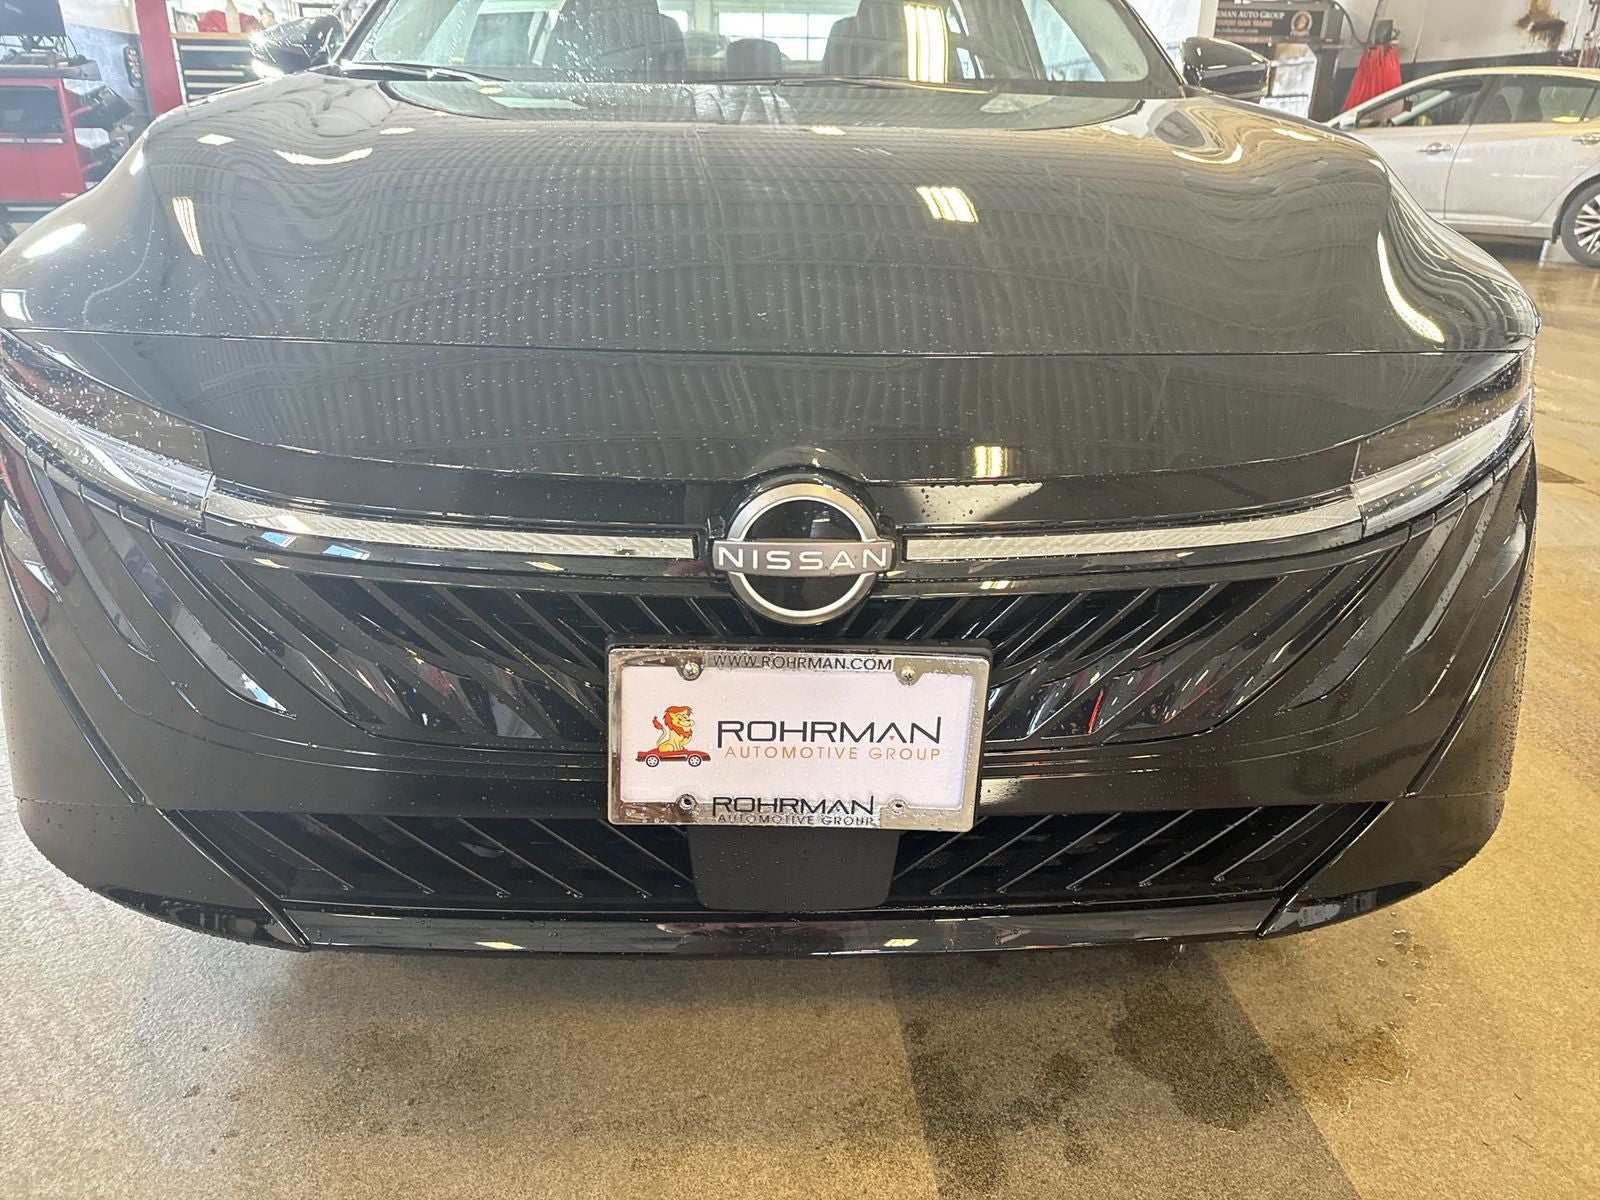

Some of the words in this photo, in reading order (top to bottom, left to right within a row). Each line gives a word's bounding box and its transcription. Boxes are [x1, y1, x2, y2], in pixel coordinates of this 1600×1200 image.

[1238, 10, 1259, 18] AUTO
[1259, 11, 1285, 19] GROUP
[718, 546, 887, 570] NISSAN
[713, 654, 893, 671] WWW.ROHRMAN.COM
[716, 716, 942, 749] ROHRMAN
[724, 745, 858, 760] AUTOMOTIVE
[869, 747, 941, 761] GROUP
[712, 795, 875, 817] ROHRMAN
[717, 814, 815, 825] AUTOMOTIVE
[821, 815, 875, 827] GROUP
